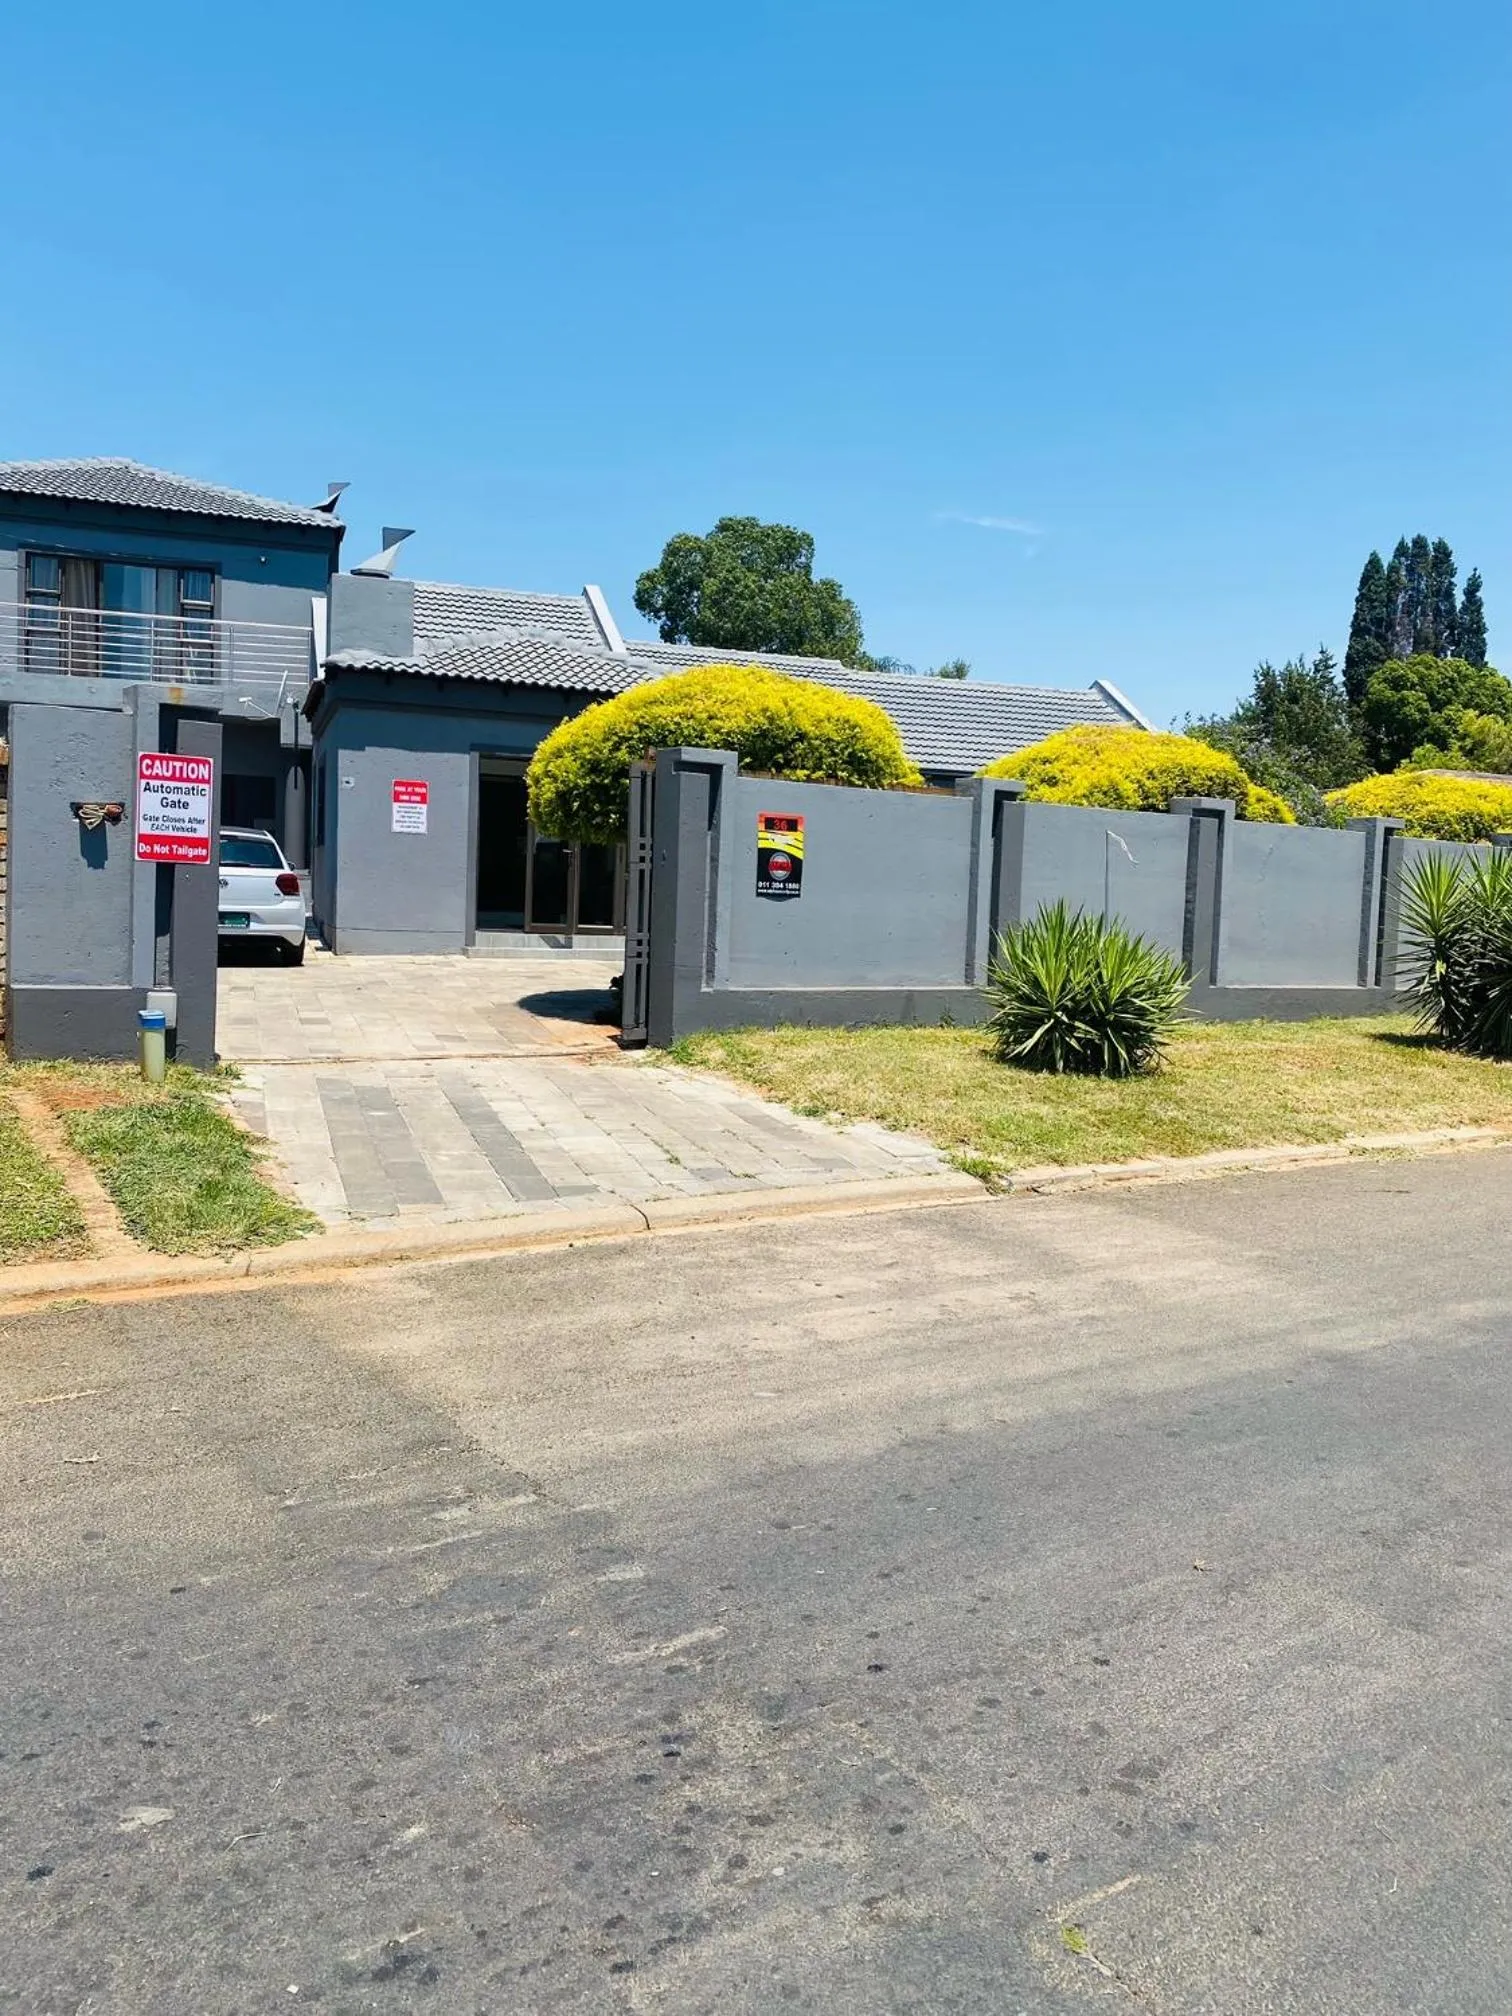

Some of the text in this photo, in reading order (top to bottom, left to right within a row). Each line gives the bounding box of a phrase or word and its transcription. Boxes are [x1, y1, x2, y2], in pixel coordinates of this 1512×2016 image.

[142, 759, 209, 780] CAUTION
[143, 782, 207, 797] Automatic
[160, 797, 190, 810] Gate
[142, 813, 205, 825] Gate Closes After
[774, 819, 788, 831] 36
[150, 823, 198, 834] EACH Vehicle
[139, 843, 208, 858] Do Not Tailgate
